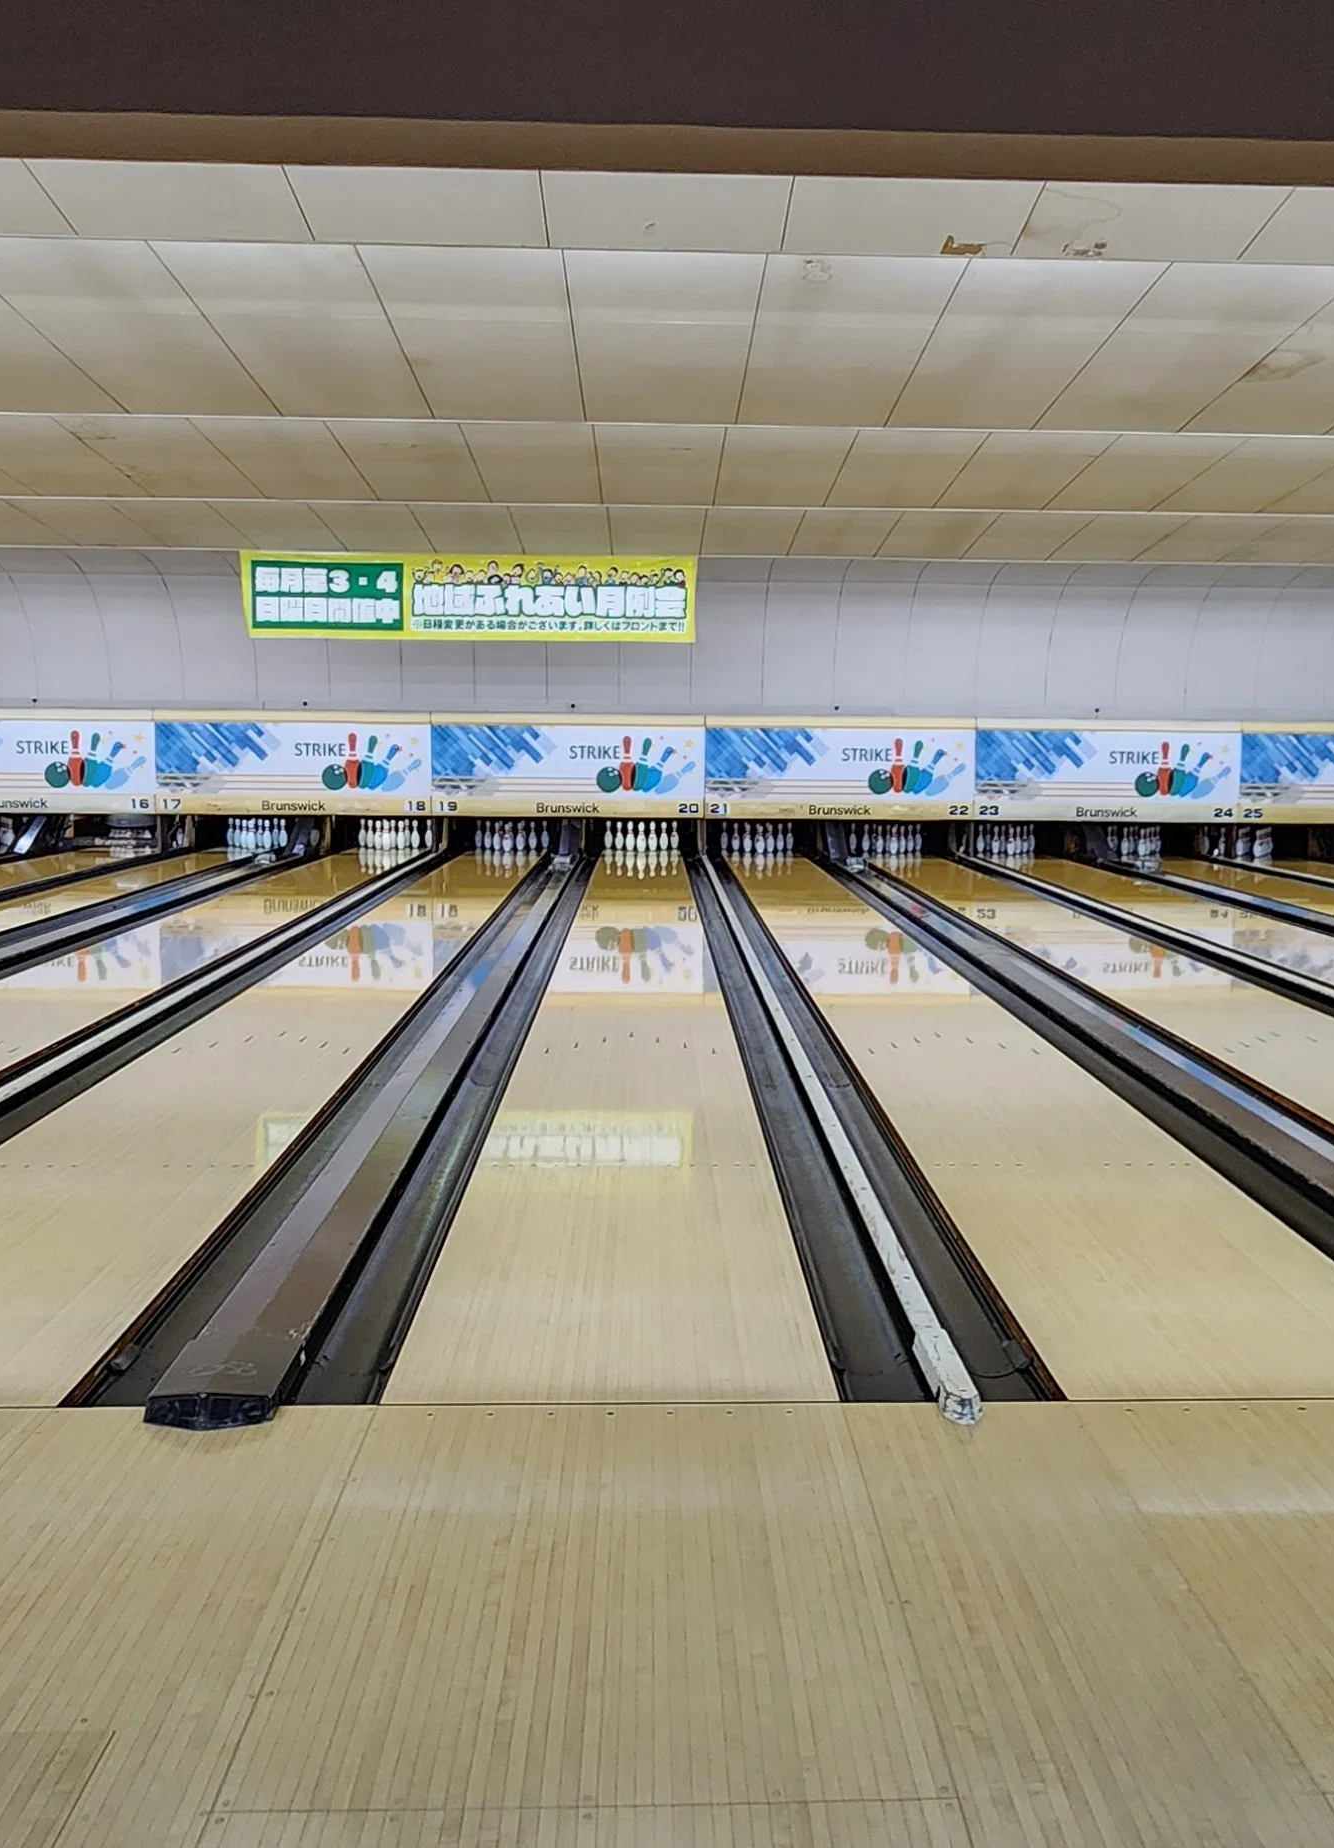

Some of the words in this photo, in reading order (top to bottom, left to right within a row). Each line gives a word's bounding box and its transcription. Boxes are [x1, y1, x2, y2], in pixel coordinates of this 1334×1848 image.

[255, 596, 400, 624] 日曜日開催中
[16, 740, 69, 755] STRIKE
[294, 742, 346, 757] STRIKE
[569, 745, 620, 760] STRIKE
[841, 747, 893, 762] STRIKE
[1108, 750, 1159, 765] STRIKE
[131, 798, 150, 809] 16
[162, 798, 181, 810] 17
[261, 800, 327, 812] Brunswick
[408, 800, 426, 812] 18
[439, 801, 458, 812] 19
[536, 802, 600, 814] Brunswick
[678, 803, 699, 814] 20
[709, 803, 728, 814] 21
[808, 804, 871, 816] Brunswick
[948, 805, 969, 816] 22
[978, 805, 999, 816] 23
[1075, 806, 1138, 818] Brunswick
[1213, 807, 1234, 818] 24
[1243, 808, 1264, 819] 25
